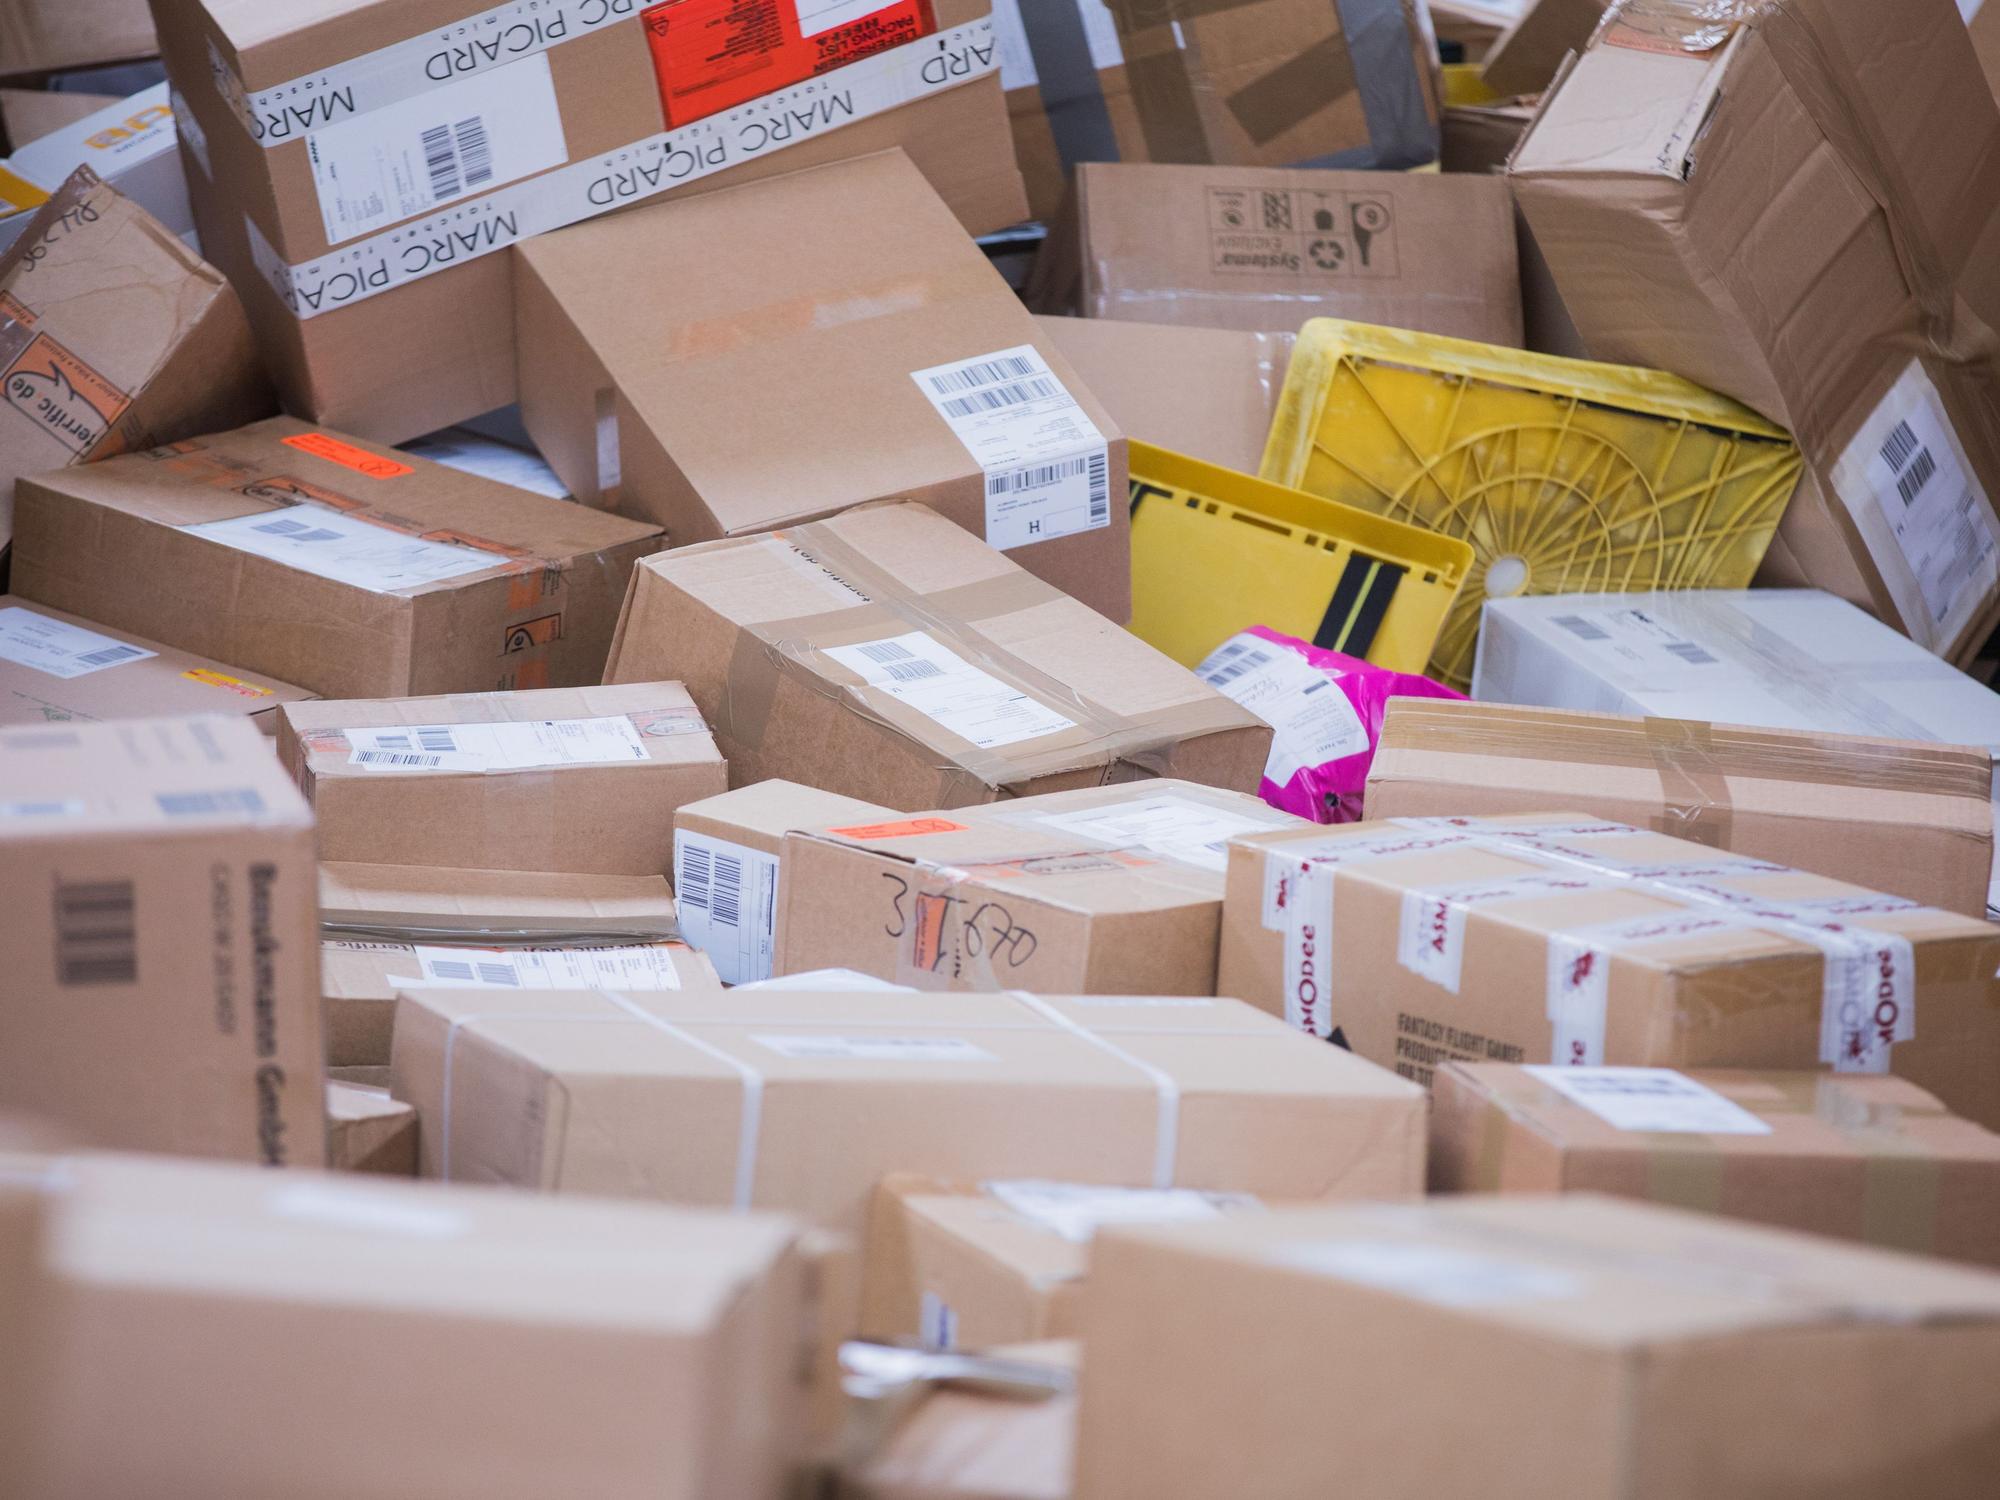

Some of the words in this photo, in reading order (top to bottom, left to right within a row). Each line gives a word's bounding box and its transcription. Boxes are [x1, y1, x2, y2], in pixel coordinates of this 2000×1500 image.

[425, 8, 568, 81] PICARD
[818, 36, 849, 60] LIST
[851, 14, 915, 46] PACKING
[730, 82, 830, 122] Taschen
[740, 90, 855, 152] MARC
[586, 134, 727, 206] PICARD
[391, 201, 493, 244] Taschen
[403, 210, 519, 274] MARC
[296, 258, 390, 311] PICA
[1029, 520, 1041, 535] H
[1397, 1012, 1444, 1042] FANTASY
[1445, 1022, 1487, 1053] FLIGHT
[1487, 1038, 1525, 1064] GAMES
